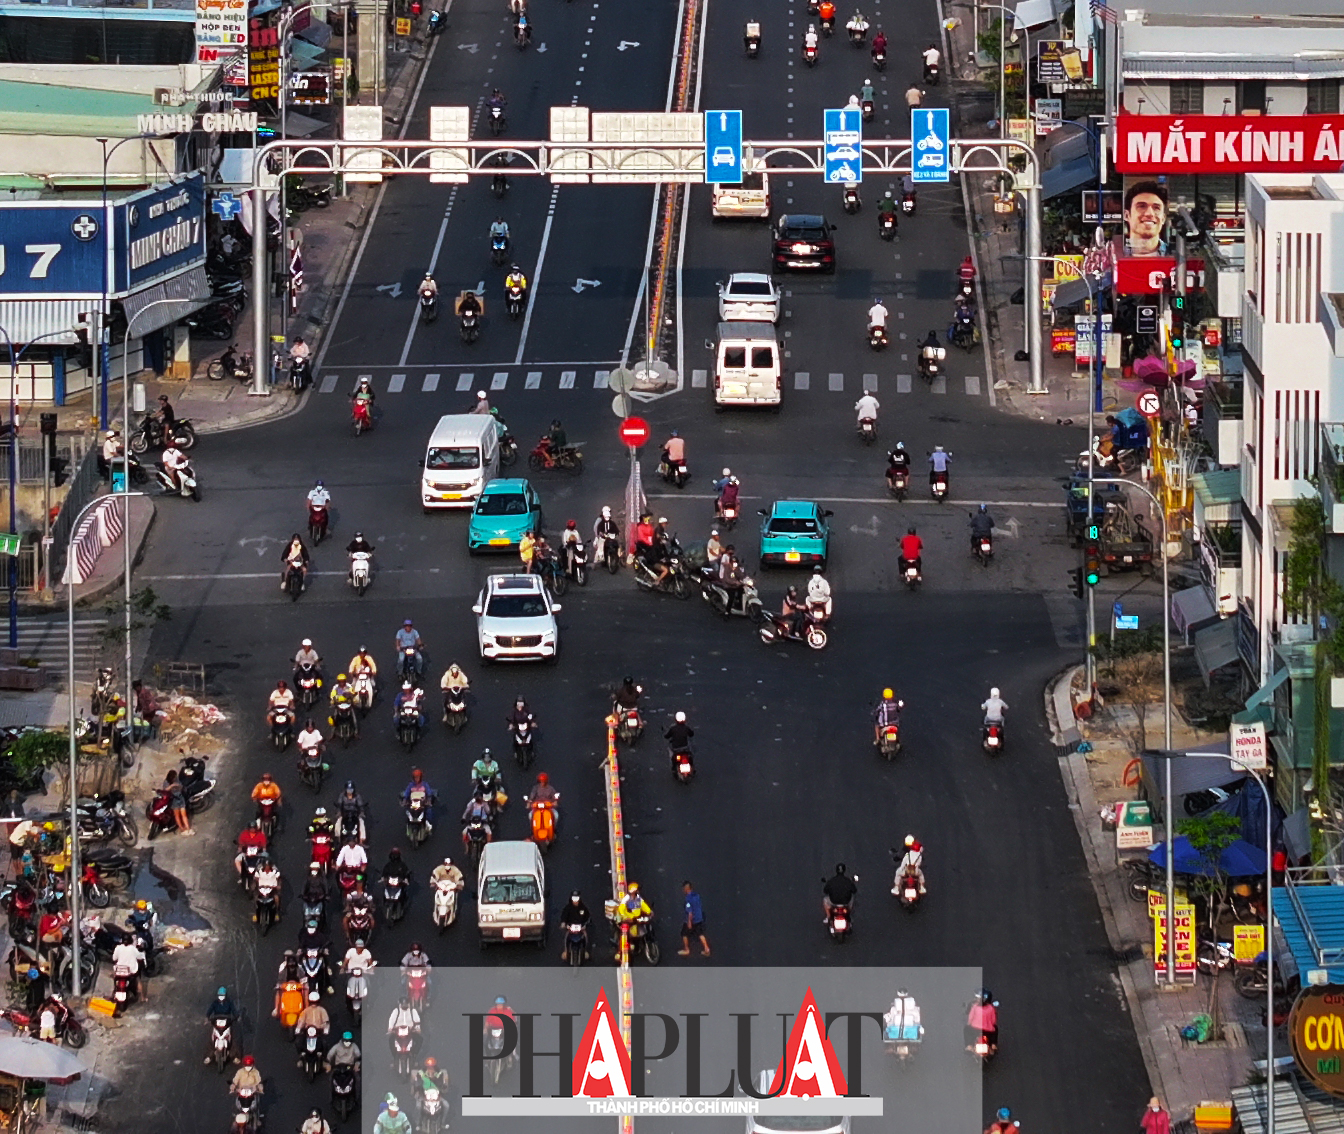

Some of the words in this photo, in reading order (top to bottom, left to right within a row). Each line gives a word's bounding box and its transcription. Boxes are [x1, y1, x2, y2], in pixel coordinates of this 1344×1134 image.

[223, 33, 246, 43] LED
[137, 112, 193, 133] MINH
[202, 108, 258, 133] CHÂU
[1127, 119, 1206, 163] MẮT
[1214, 124, 1304, 163] KÍNH
[131, 231, 161, 270] MINH
[162, 216, 191, 256] CHÂU
[192, 215, 201, 244] 7
[25, 244, 62, 279] 7
[1317, 1054, 1341, 1074] MÌ
